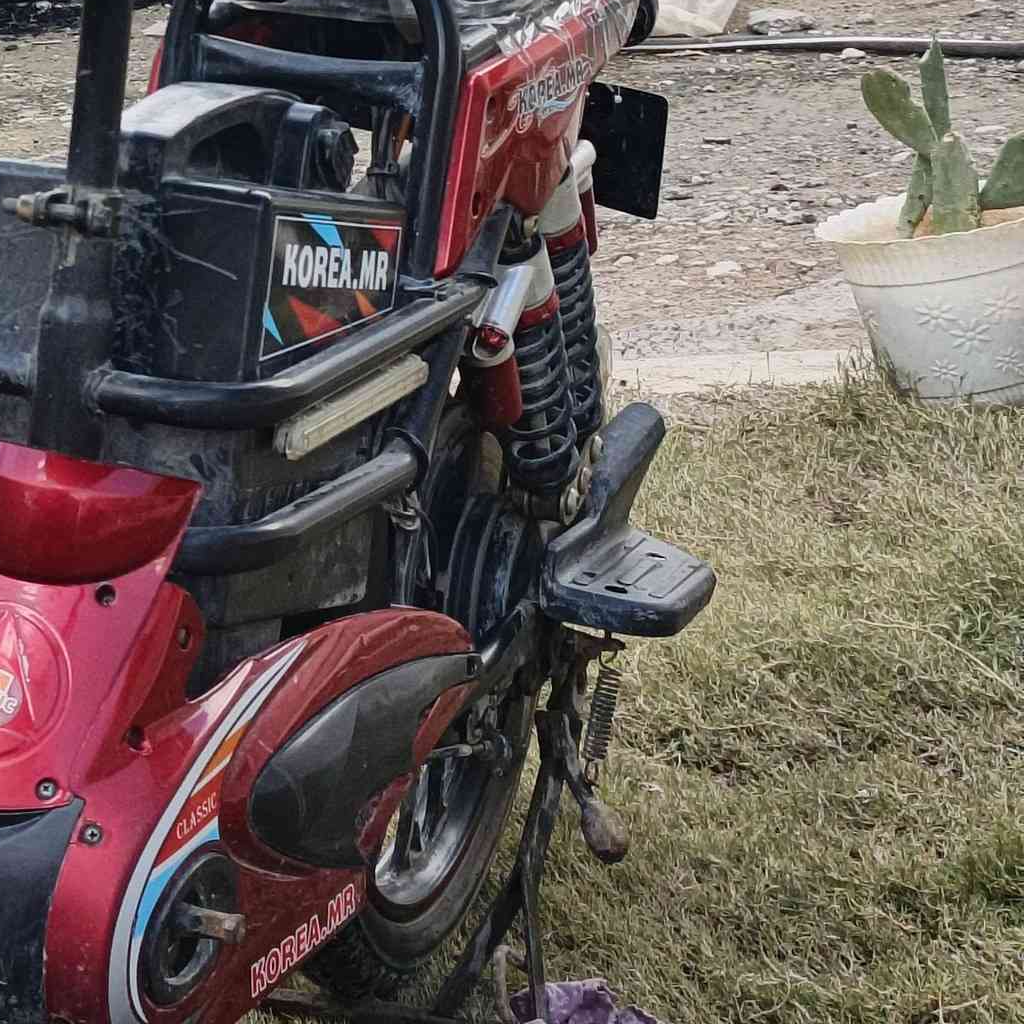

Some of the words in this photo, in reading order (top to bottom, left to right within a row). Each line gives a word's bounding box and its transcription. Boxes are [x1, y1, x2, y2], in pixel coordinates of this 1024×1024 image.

[281, 243, 389, 291] KOREA.MR
[176, 792, 217, 839] CLASSIC
[250, 883, 356, 998] KOREA.MR
